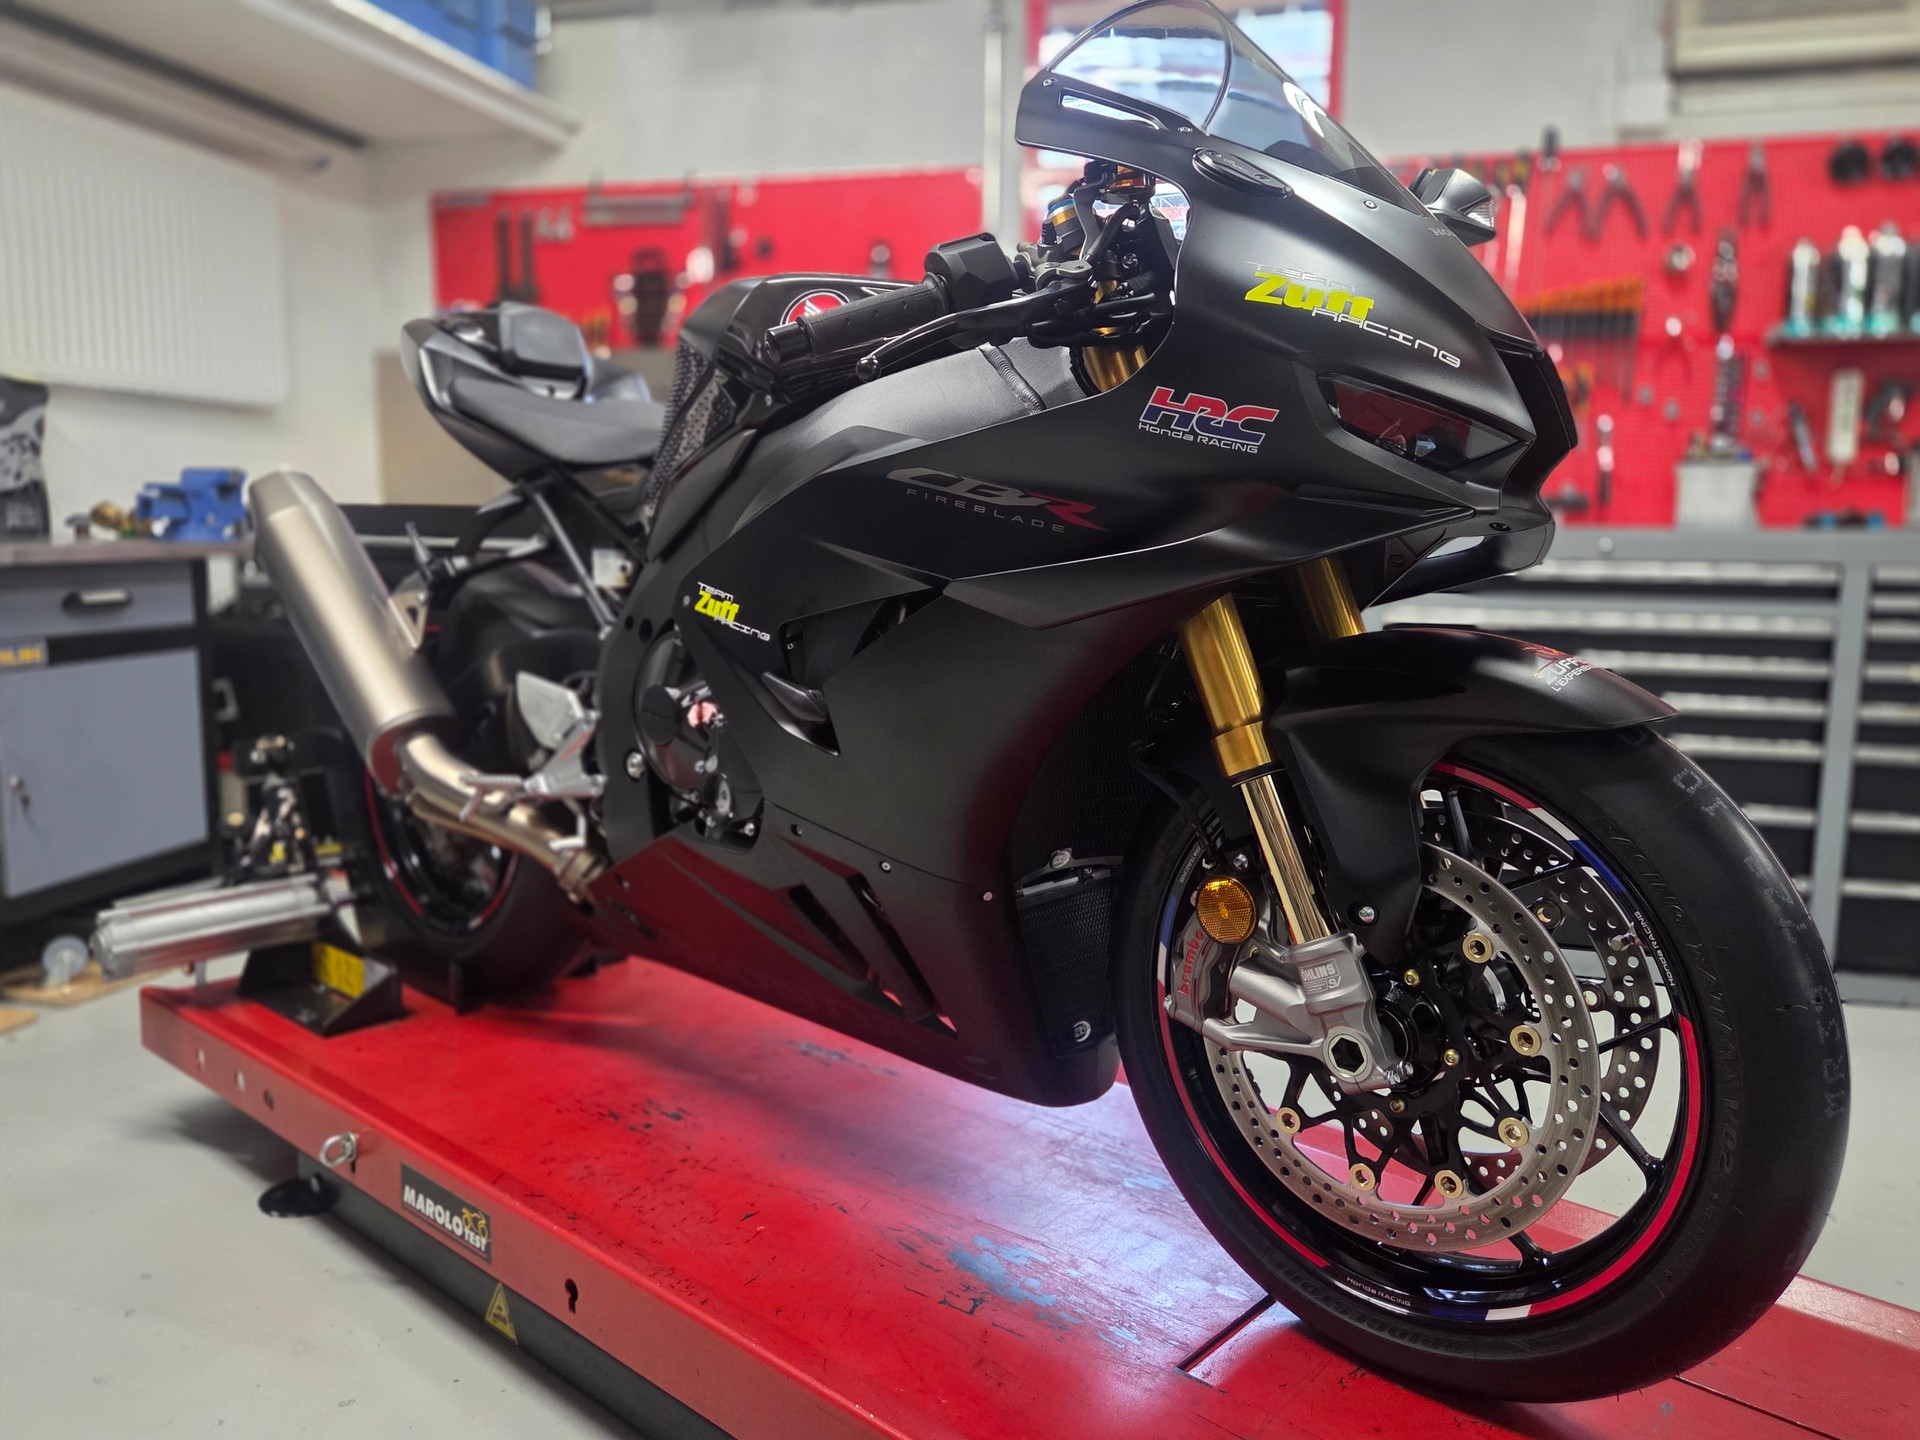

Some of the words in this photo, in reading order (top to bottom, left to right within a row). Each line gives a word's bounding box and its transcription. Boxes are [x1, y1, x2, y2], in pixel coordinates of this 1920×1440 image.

[1244, 271, 1375, 321] Zuff
[1311, 307, 1461, 368] RACING
[1139, 385, 1280, 445] HRC
[1138, 422, 1194, 441] Honda
[1197, 435, 1259, 454] RACING
[886, 466, 1108, 532] CBR
[905, 487, 1066, 534] FIREBLADE
[694, 590, 740, 624] Zuff
[697, 581, 734, 602] TEAM
[1634, 910, 1659, 949] RACING
[1177, 929, 1205, 996] brembo
[1656, 949, 1676, 987] Honda
[403, 1184, 463, 1237] MAROLO
[464, 1228, 488, 1252] TEST
[1346, 1276, 1377, 1295] Honda
[1377, 1290, 1411, 1307] RACING
